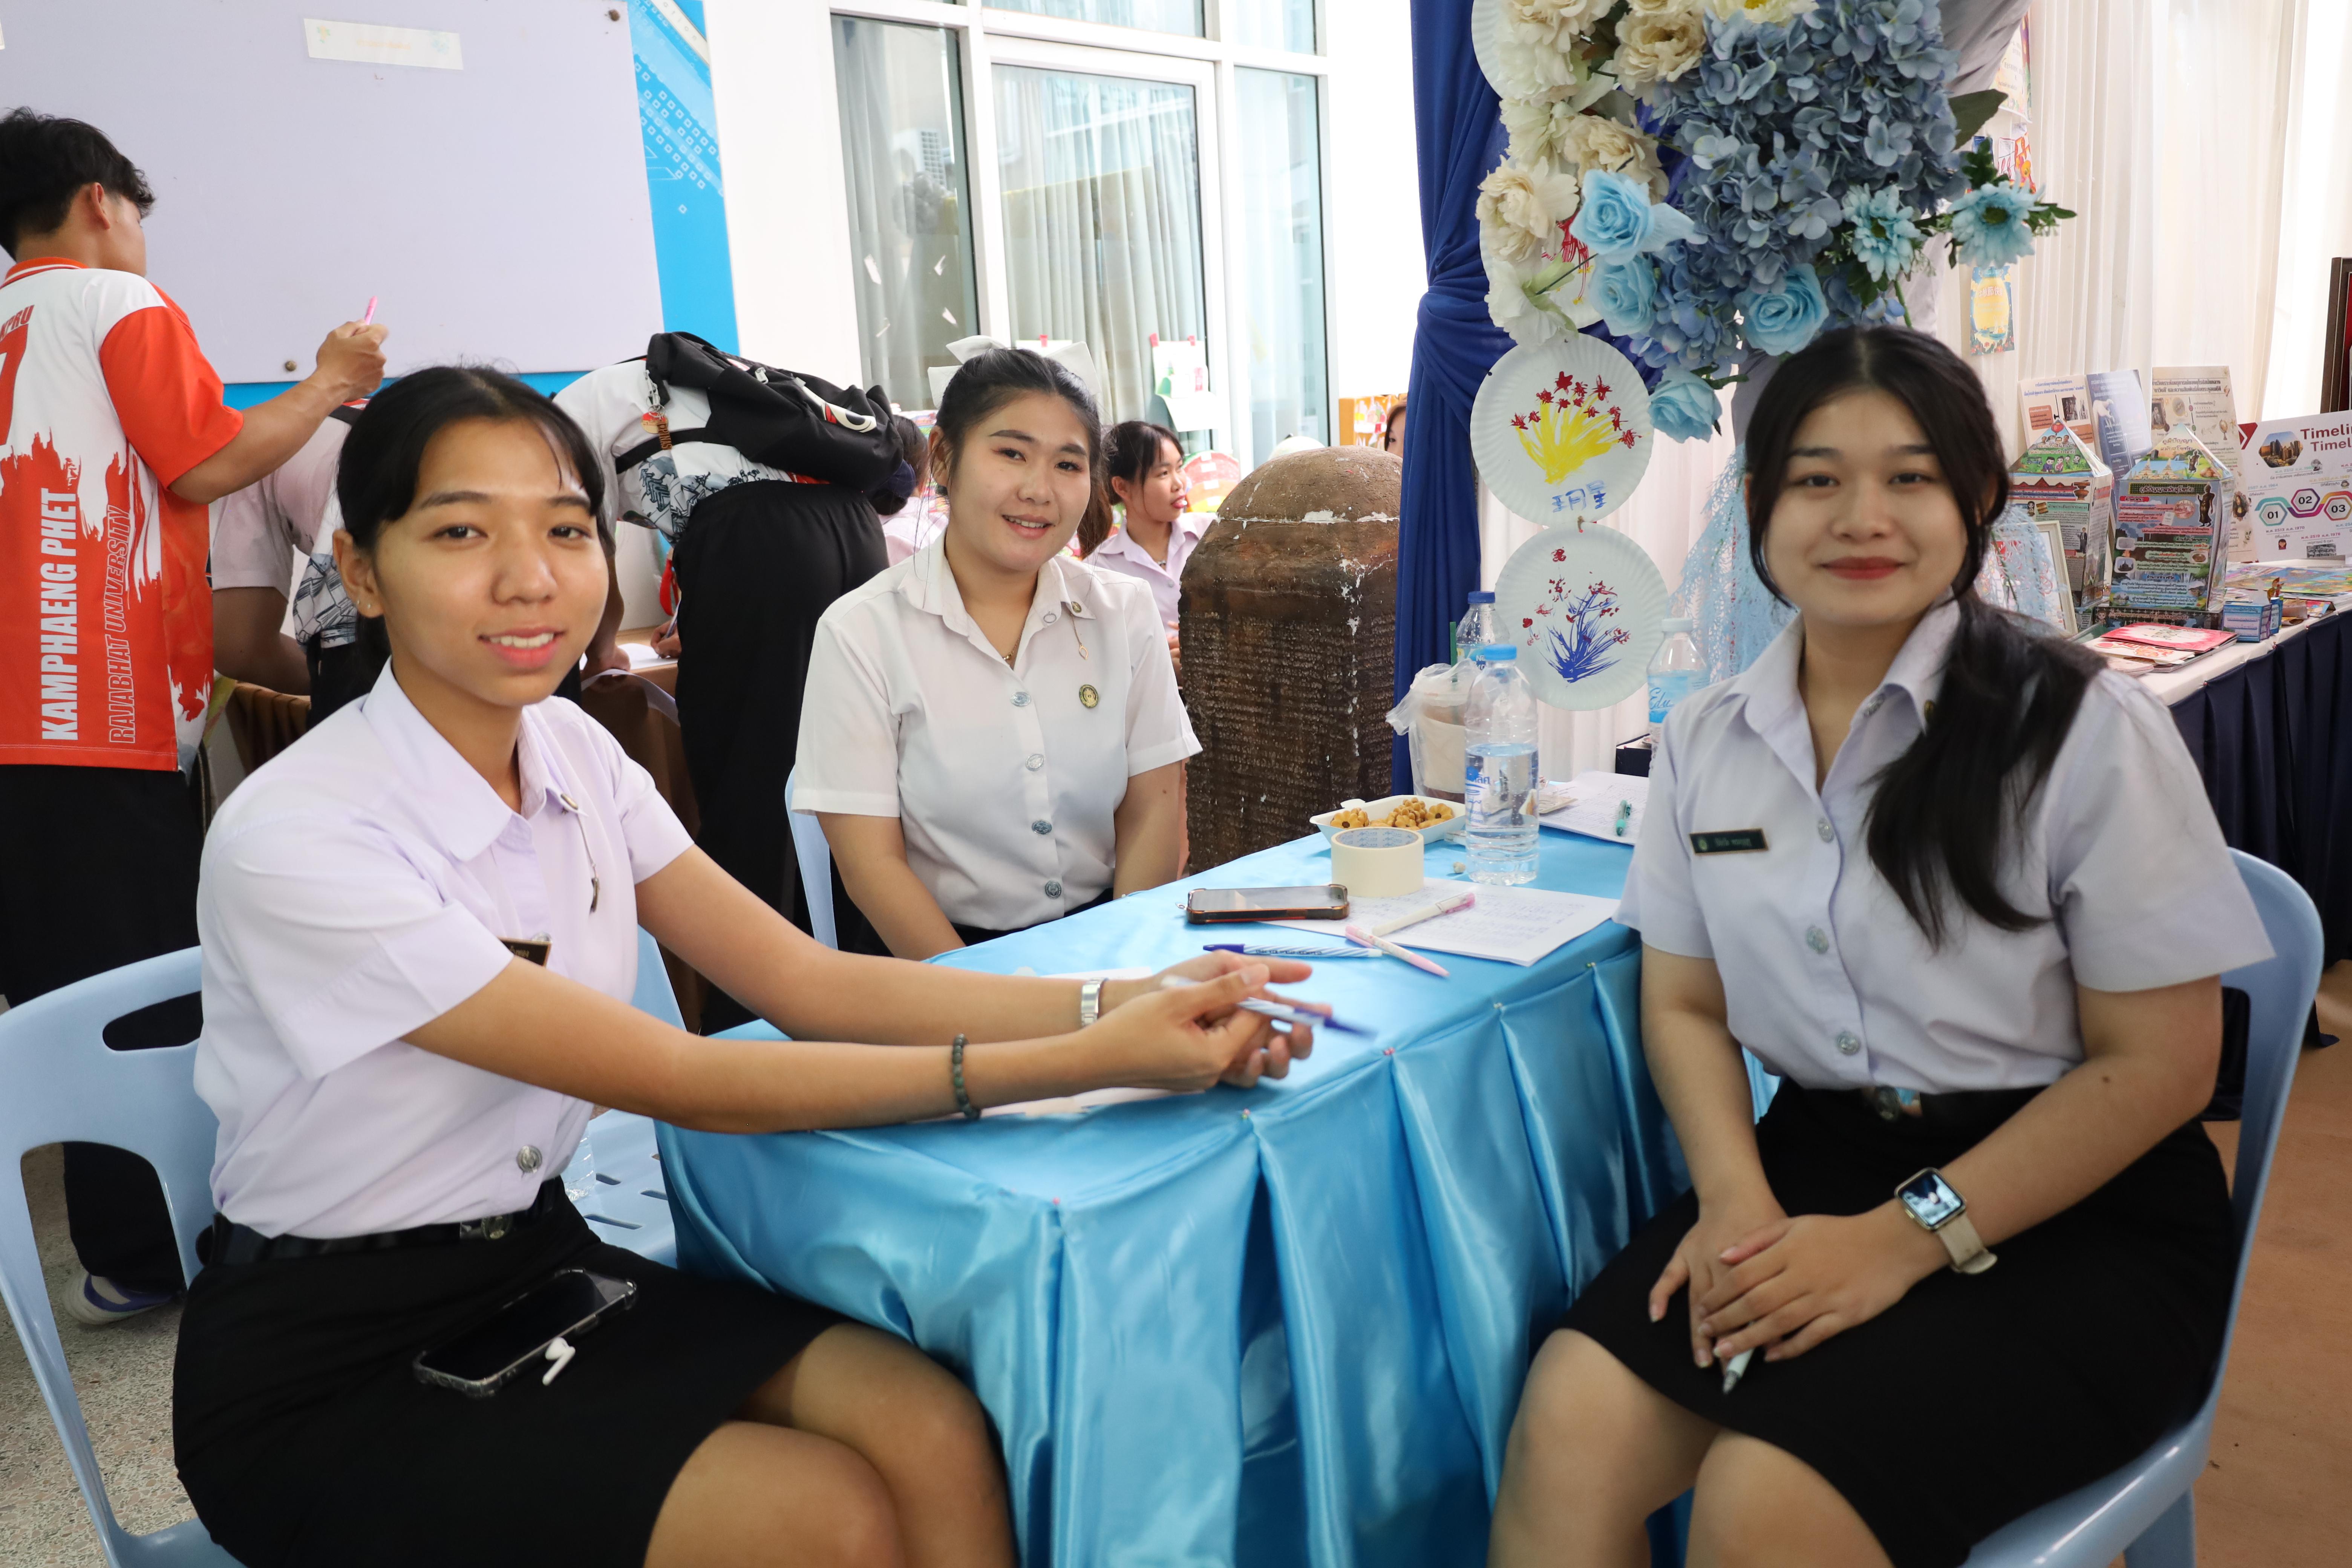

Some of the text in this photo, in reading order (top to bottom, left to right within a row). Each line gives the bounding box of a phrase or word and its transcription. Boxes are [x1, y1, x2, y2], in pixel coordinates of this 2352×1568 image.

[40, 488, 79, 741] KAMPHAENG PHET
[103, 505, 136, 744] RAJABHAT UNIVERSITY
[2331, 505, 2346, 513] 03
